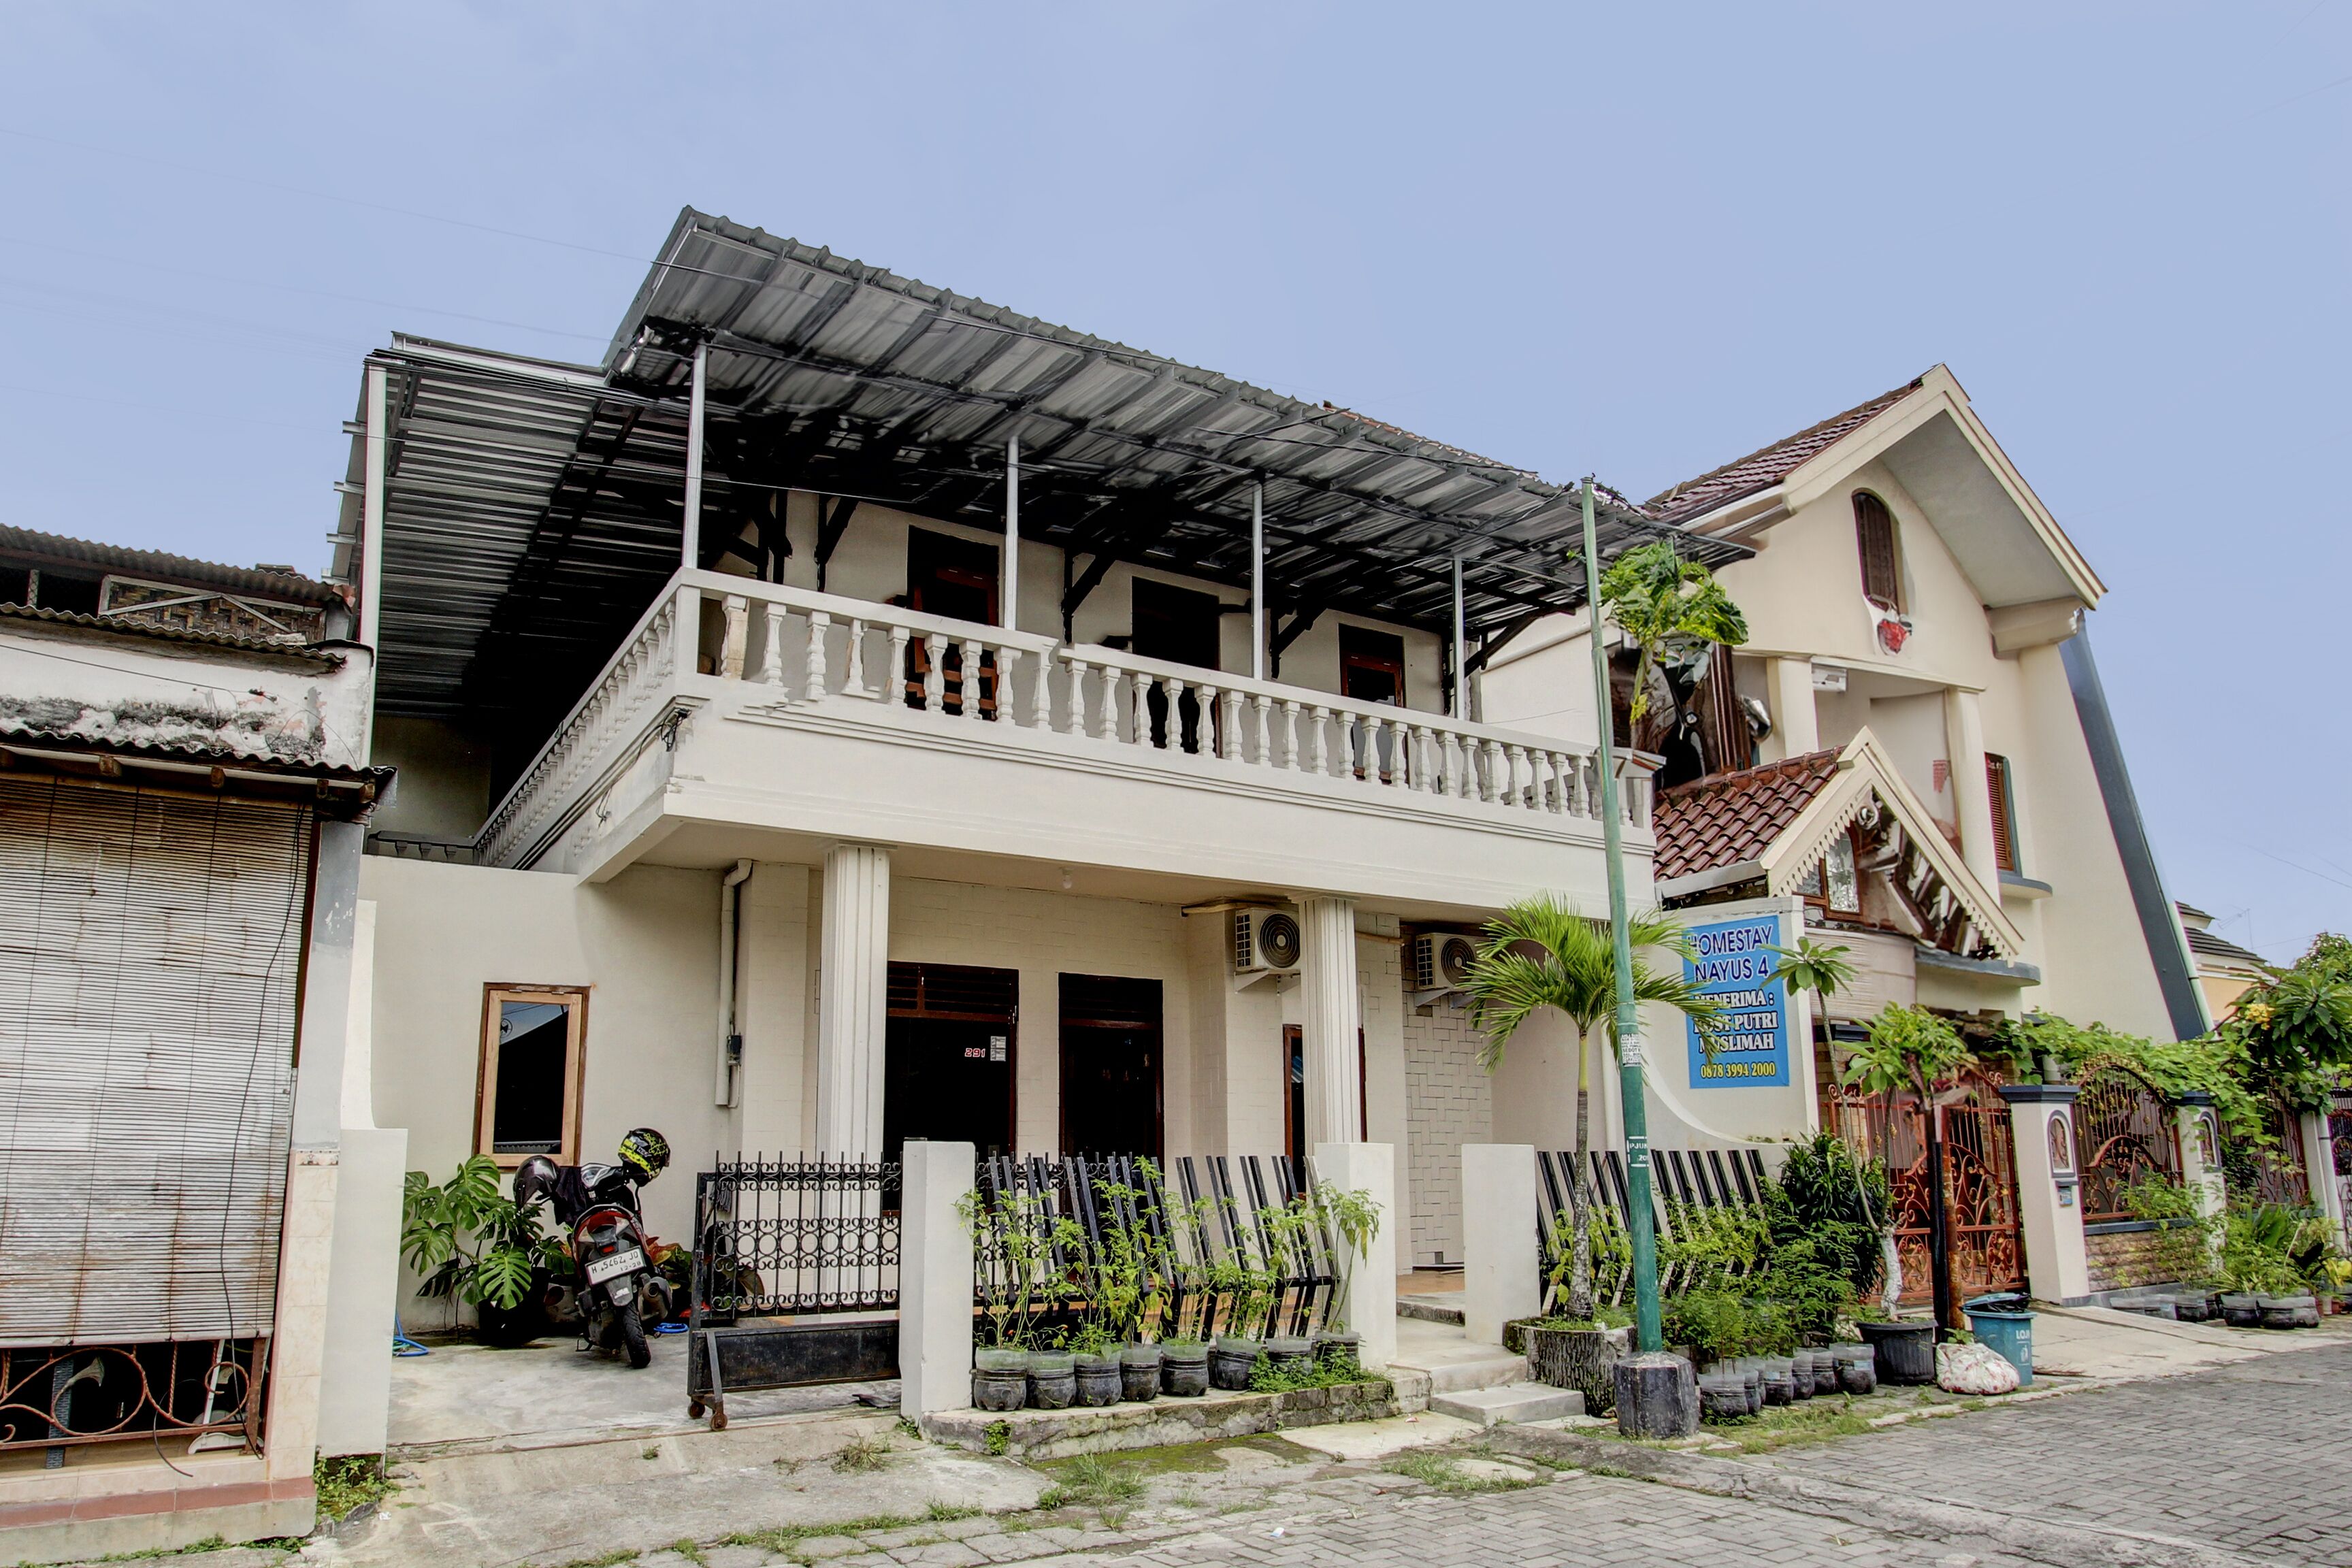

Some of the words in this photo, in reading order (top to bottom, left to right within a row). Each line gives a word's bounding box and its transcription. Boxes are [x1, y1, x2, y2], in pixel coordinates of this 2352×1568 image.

[1695, 958, 1753, 983] NAYUS
[1757, 955, 1770, 979] 4
[1733, 1011, 1779, 1031] PUTRI
[964, 1048, 985, 1058] 291
[1701, 1063, 1723, 1079] 0878
[1725, 1062, 1749, 1078] 3994
[1751, 1061, 1776, 1077] 2000
